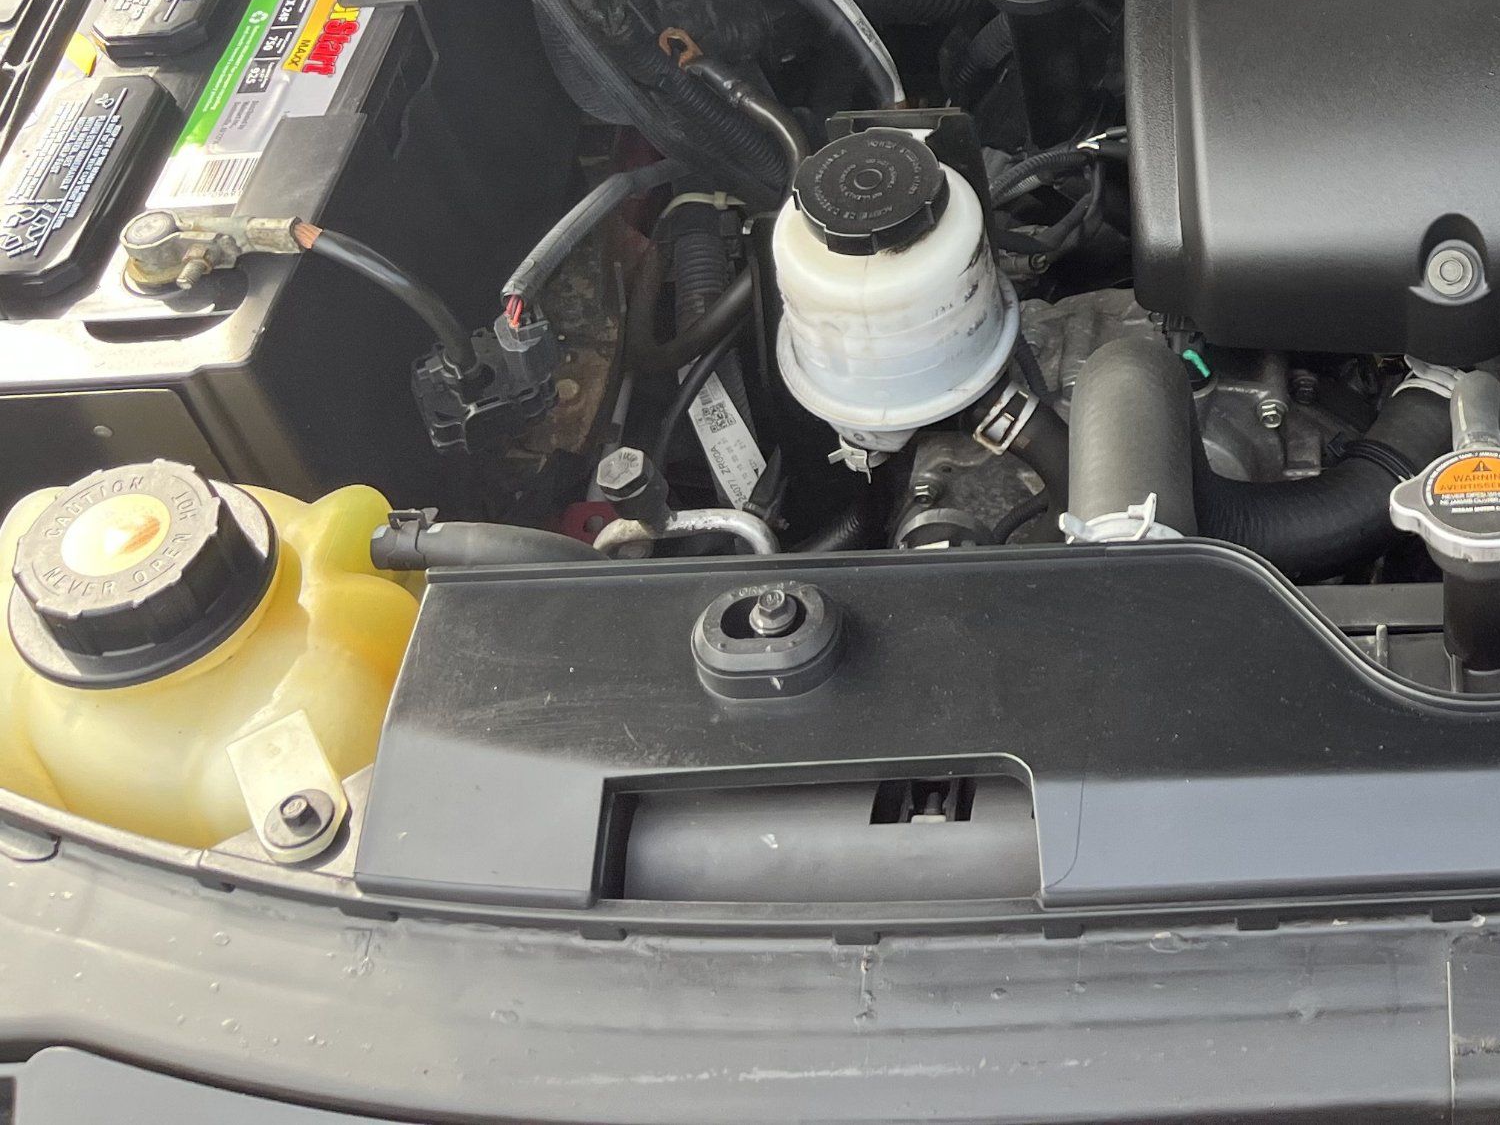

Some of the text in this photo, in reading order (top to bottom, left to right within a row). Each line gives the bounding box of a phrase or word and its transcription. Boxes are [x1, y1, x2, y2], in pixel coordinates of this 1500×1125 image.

[276, 6, 294, 22] 24F
[261, 35, 279, 51] 750
[287, 39, 311, 66] MAXX
[243, 67, 262, 84] 925
[45, 476, 144, 538] CAUTION
[43, 567, 117, 596] NEVER
[132, 533, 192, 583] OPEN
